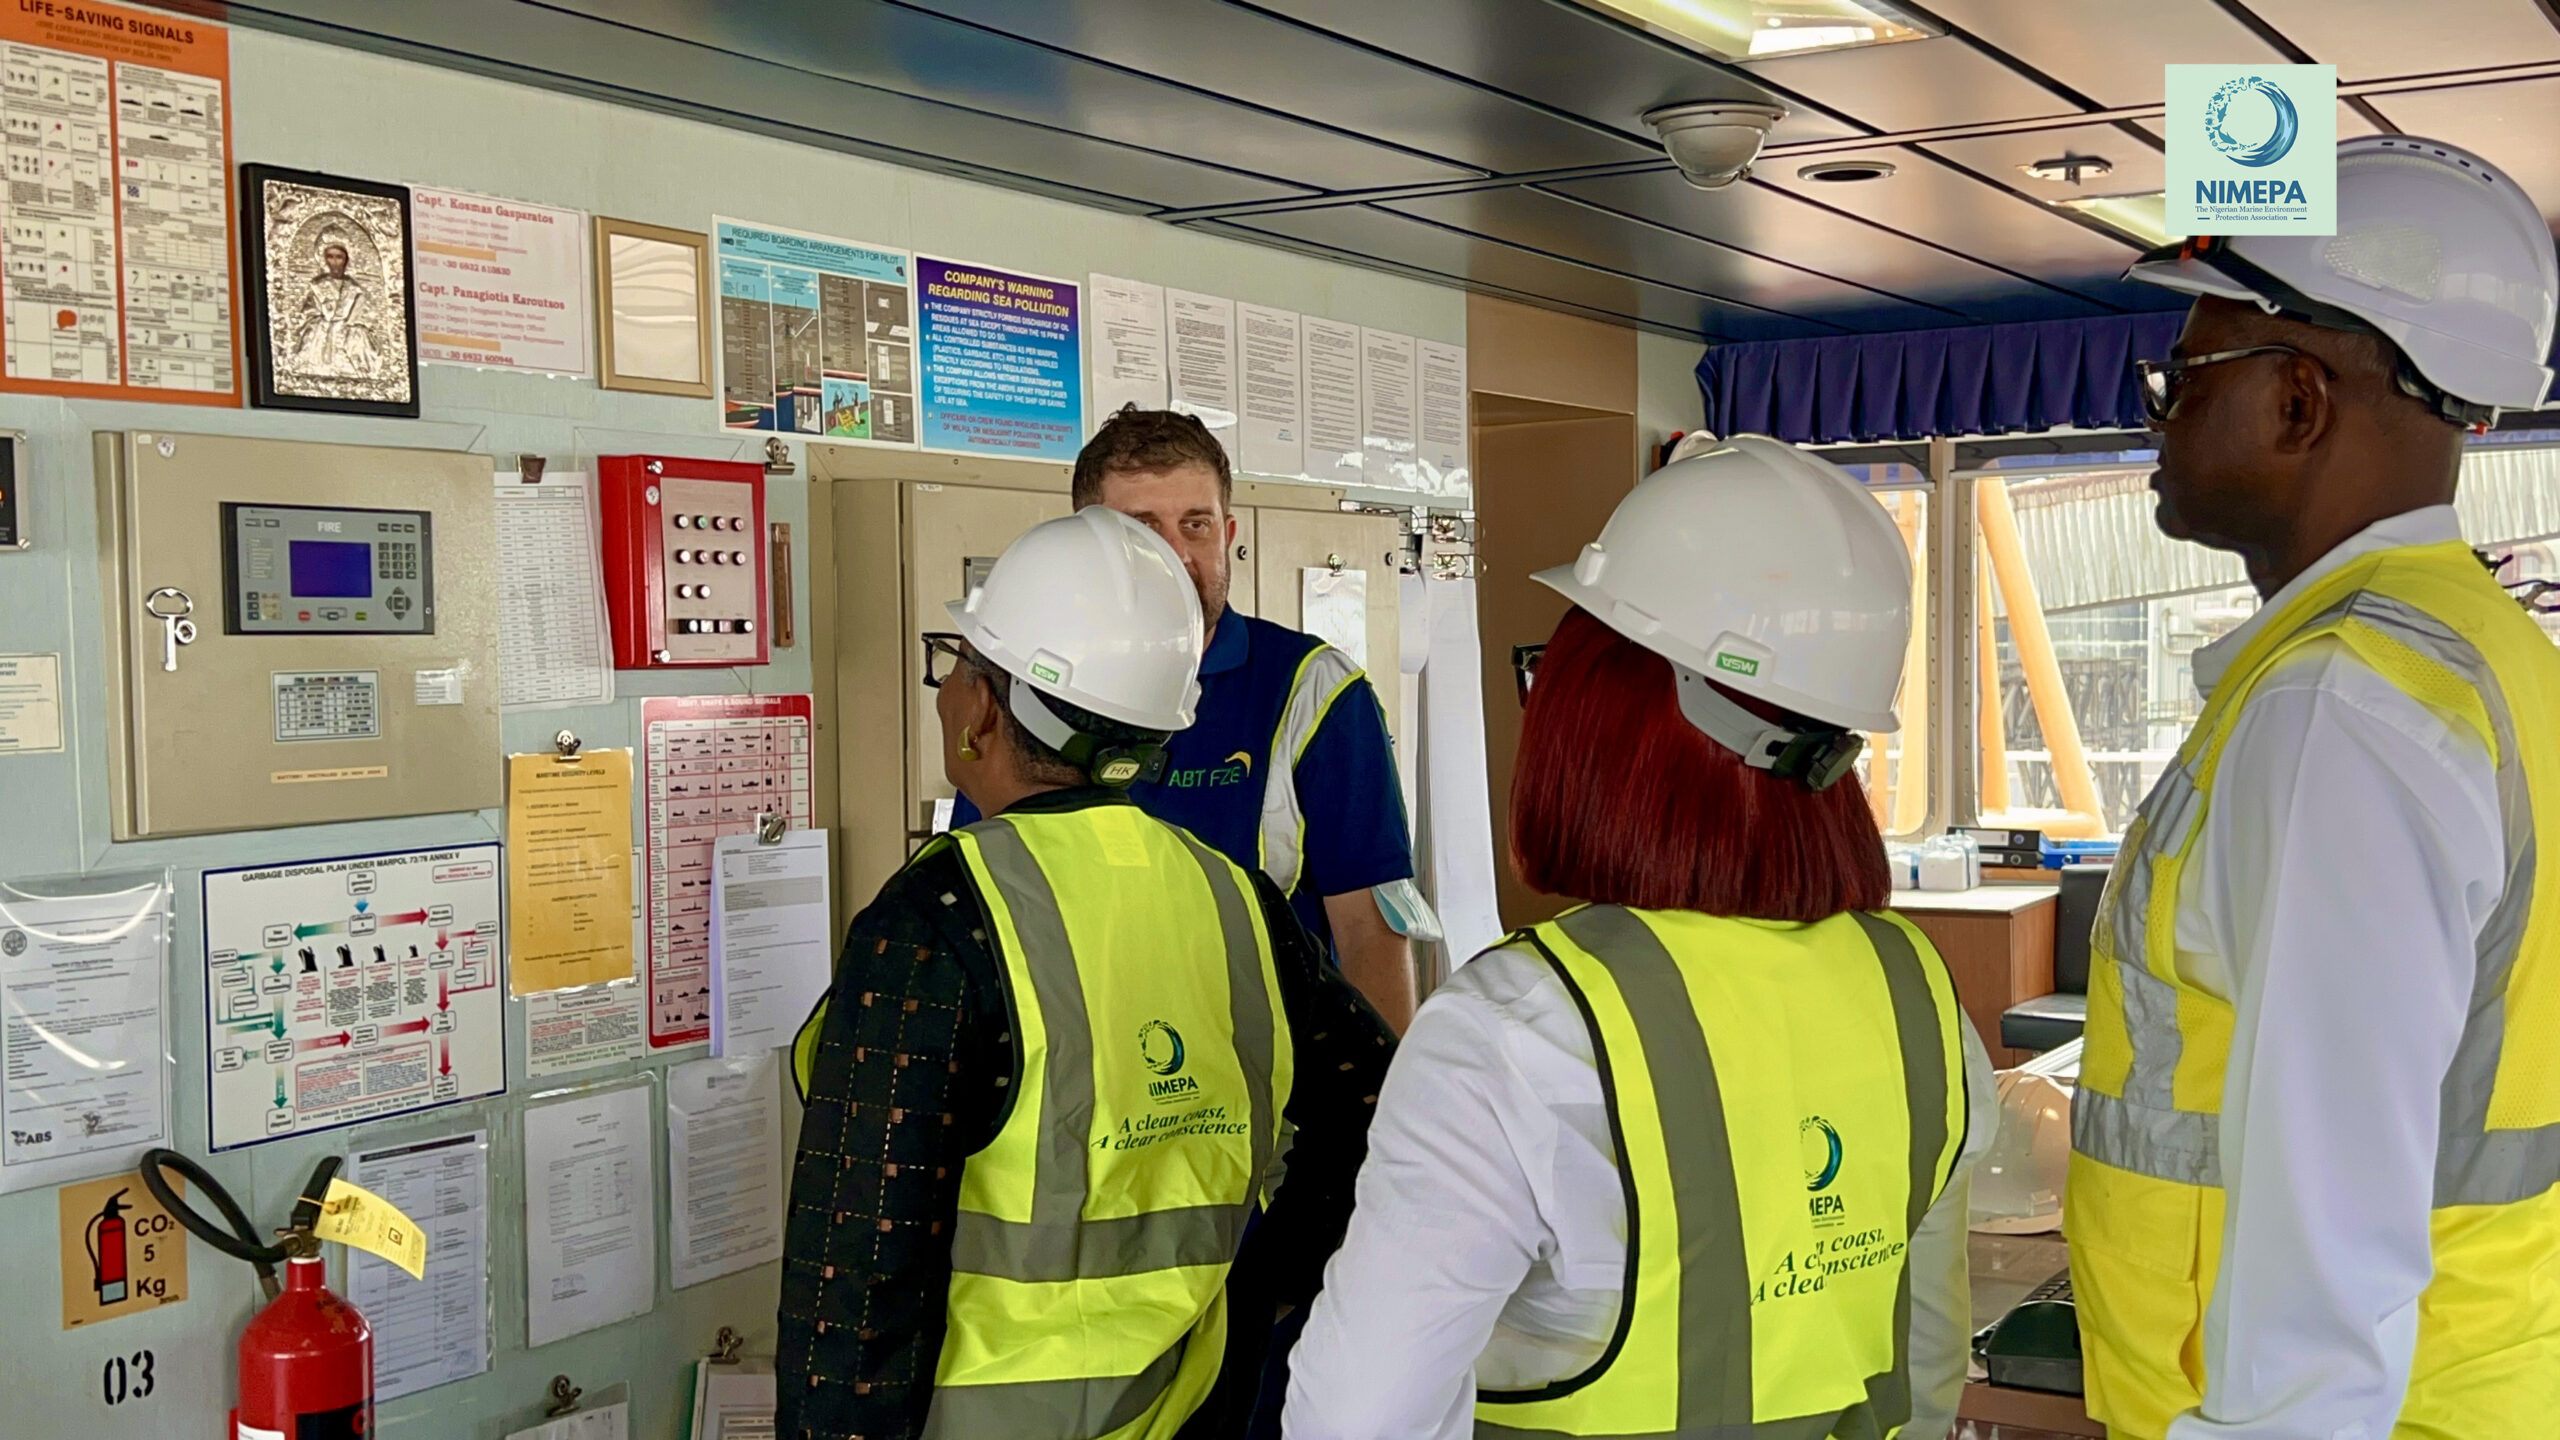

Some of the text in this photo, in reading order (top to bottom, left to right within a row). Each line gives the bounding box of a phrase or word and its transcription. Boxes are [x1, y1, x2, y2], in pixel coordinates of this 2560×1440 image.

[20, 0, 124, 30] LIFE-SAVING
[128, 19, 194, 44] SIGNALS
[416, 192, 445, 209] Capt.
[450, 198, 492, 214] Kosmas
[495, 205, 554, 224] Gasparatos
[732, 228, 771, 243] REQUIRED
[771, 235, 808, 250] BOARDING
[809, 242, 865, 259] ARRANGEMENTS
[865, 250, 880, 261] FOR
[880, 253, 899, 264] PILOT
[419, 282, 565, 310] Capt. Panagiotis Karoutsos
[944, 270, 1054, 300] COMPANY'S WARNING
[928, 283, 1069, 317] REGARDING SEA POLLUTION
[317, 521, 342, 533] FIRE
[1720, 655, 1755, 673] MSA
[1168, 766, 1241, 787] ABT FZE
[241, 869, 283, 883] GARBAGE
[284, 865, 325, 878] DISPOSAL
[326, 863, 347, 874] PLAN
[348, 860, 375, 871] UNDER
[376, 857, 408, 868] MARPOL
[429, 852, 454, 862] ANNEX
[1091, 1119, 1247, 1150] A clear conscience
[1119, 1106, 1226, 1134] A clean coast,
[25, 1131, 52, 1144] ABS
[144, 1244, 155, 1262] 5
[1774, 1251, 1795, 1275] A
[136, 1276, 166, 1297] Kg
[1750, 1280, 1765, 1306] A
[1774, 1273, 1825, 1298] clea
[103, 1349, 155, 1406] 03
